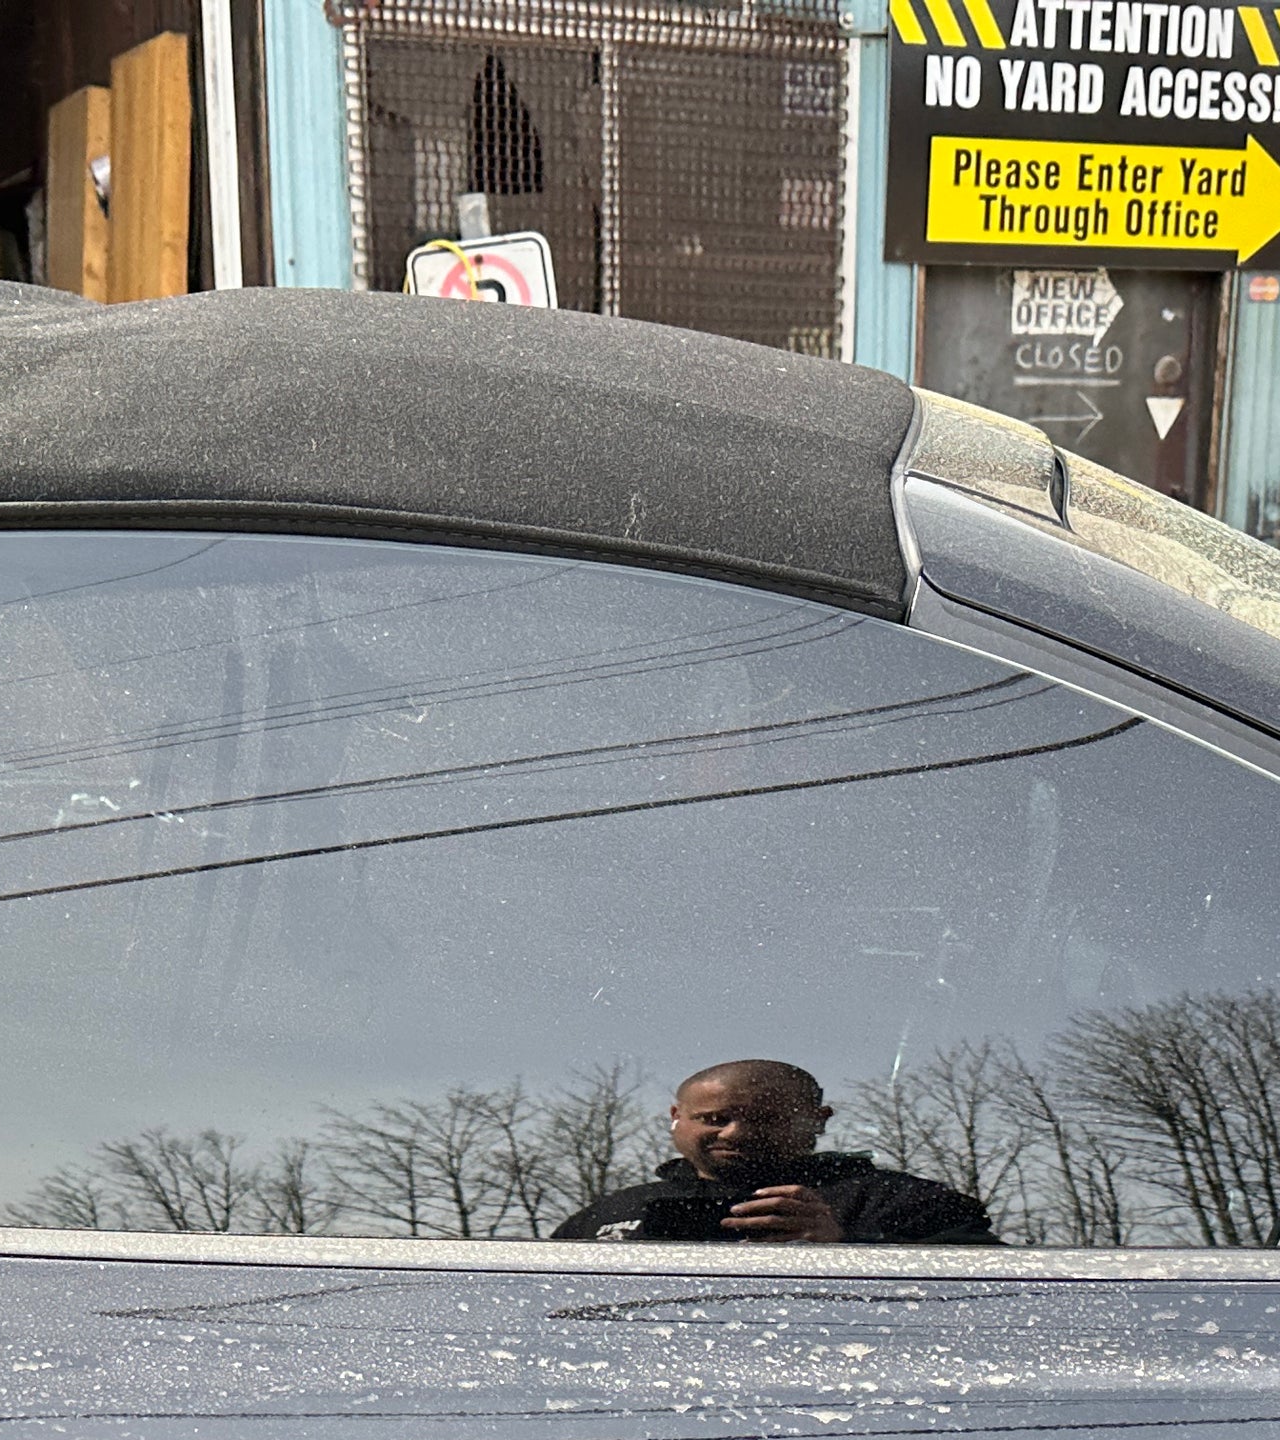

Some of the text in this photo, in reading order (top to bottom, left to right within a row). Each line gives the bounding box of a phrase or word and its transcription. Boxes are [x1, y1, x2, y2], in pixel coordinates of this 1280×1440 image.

[1009, 0, 1235, 59] ATTENTION
[926, 55, 981, 109] NO
[1000, 59, 1104, 114] YARD
[953, 148, 1247, 197] Please Enter Yard
[980, 195, 1219, 241] Through Office
[1029, 276, 1095, 300] NEW
